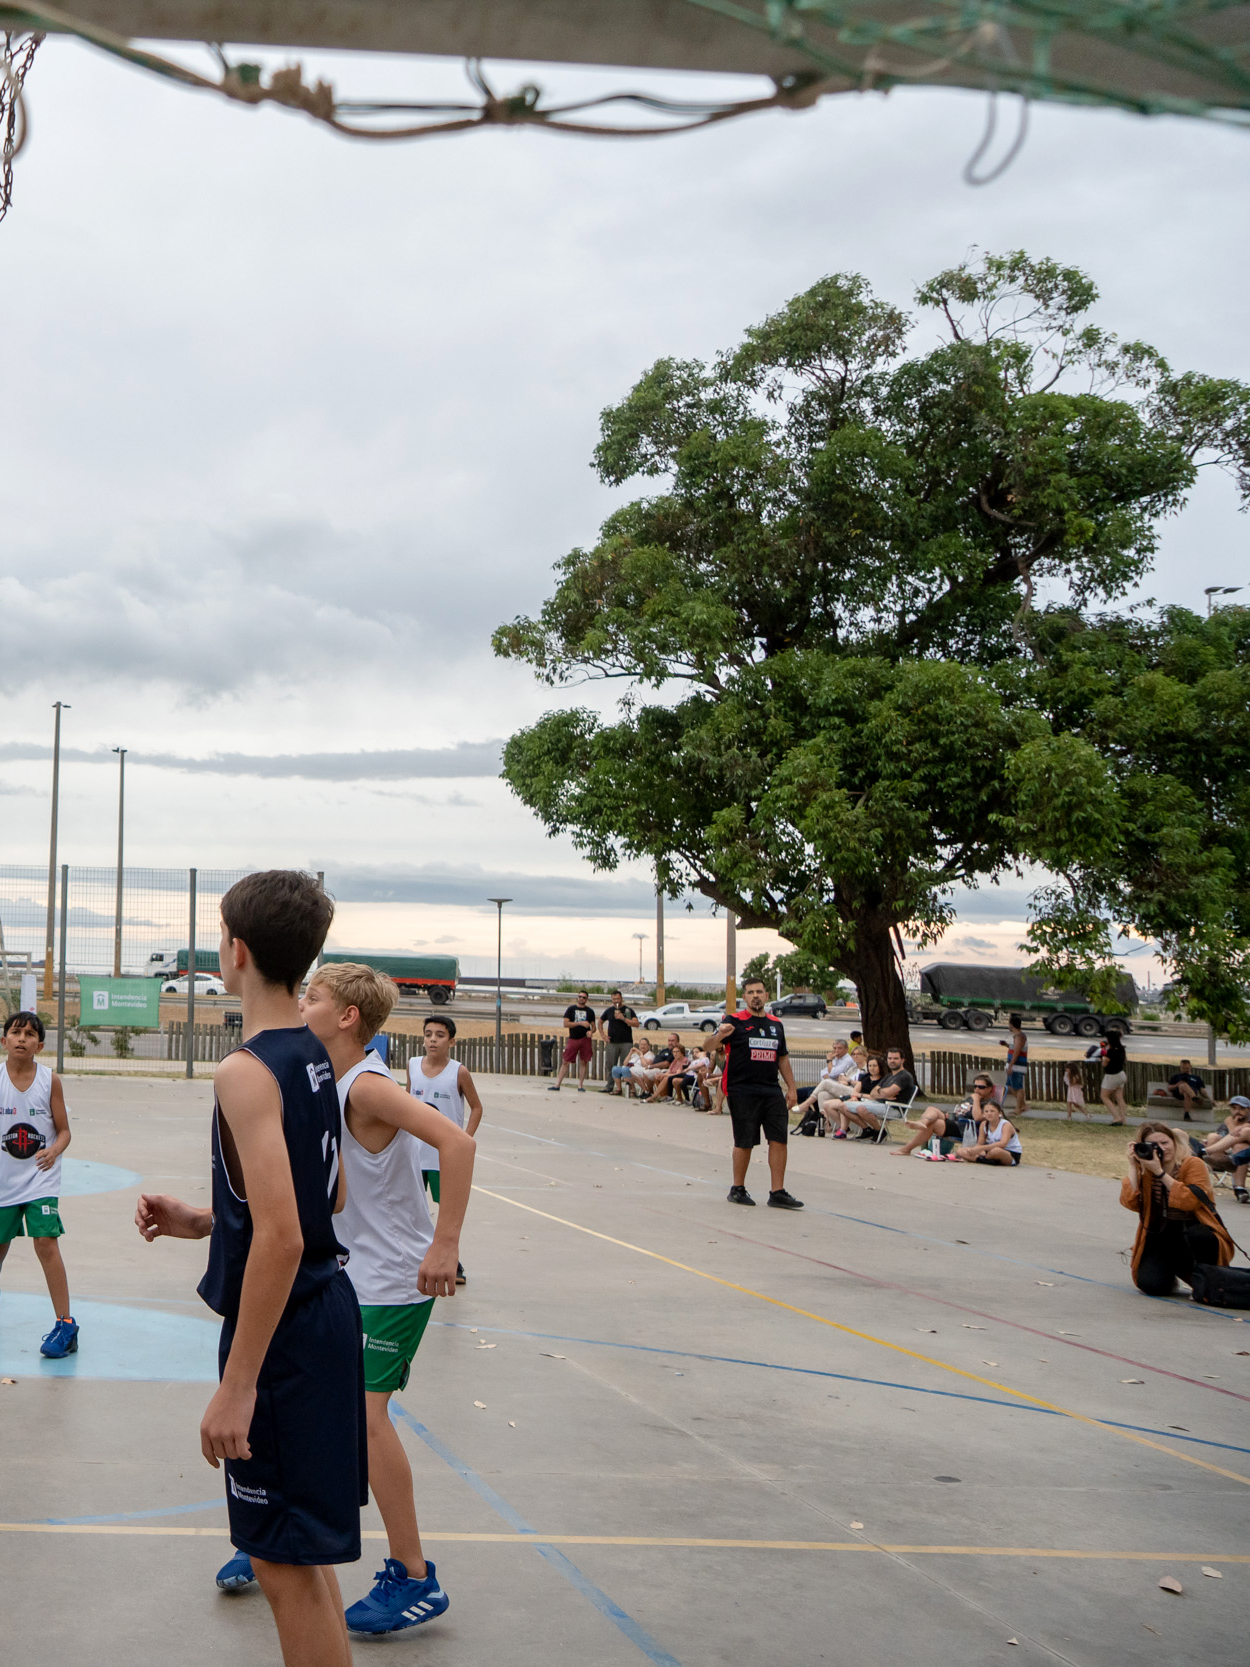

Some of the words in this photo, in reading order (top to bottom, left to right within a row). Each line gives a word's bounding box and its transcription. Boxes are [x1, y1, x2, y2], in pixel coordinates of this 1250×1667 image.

[111, 1000, 147, 1008] Montevideo
[369, 1337, 399, 1347] Intendencia
[368, 1343, 399, 1353] Montevideo
